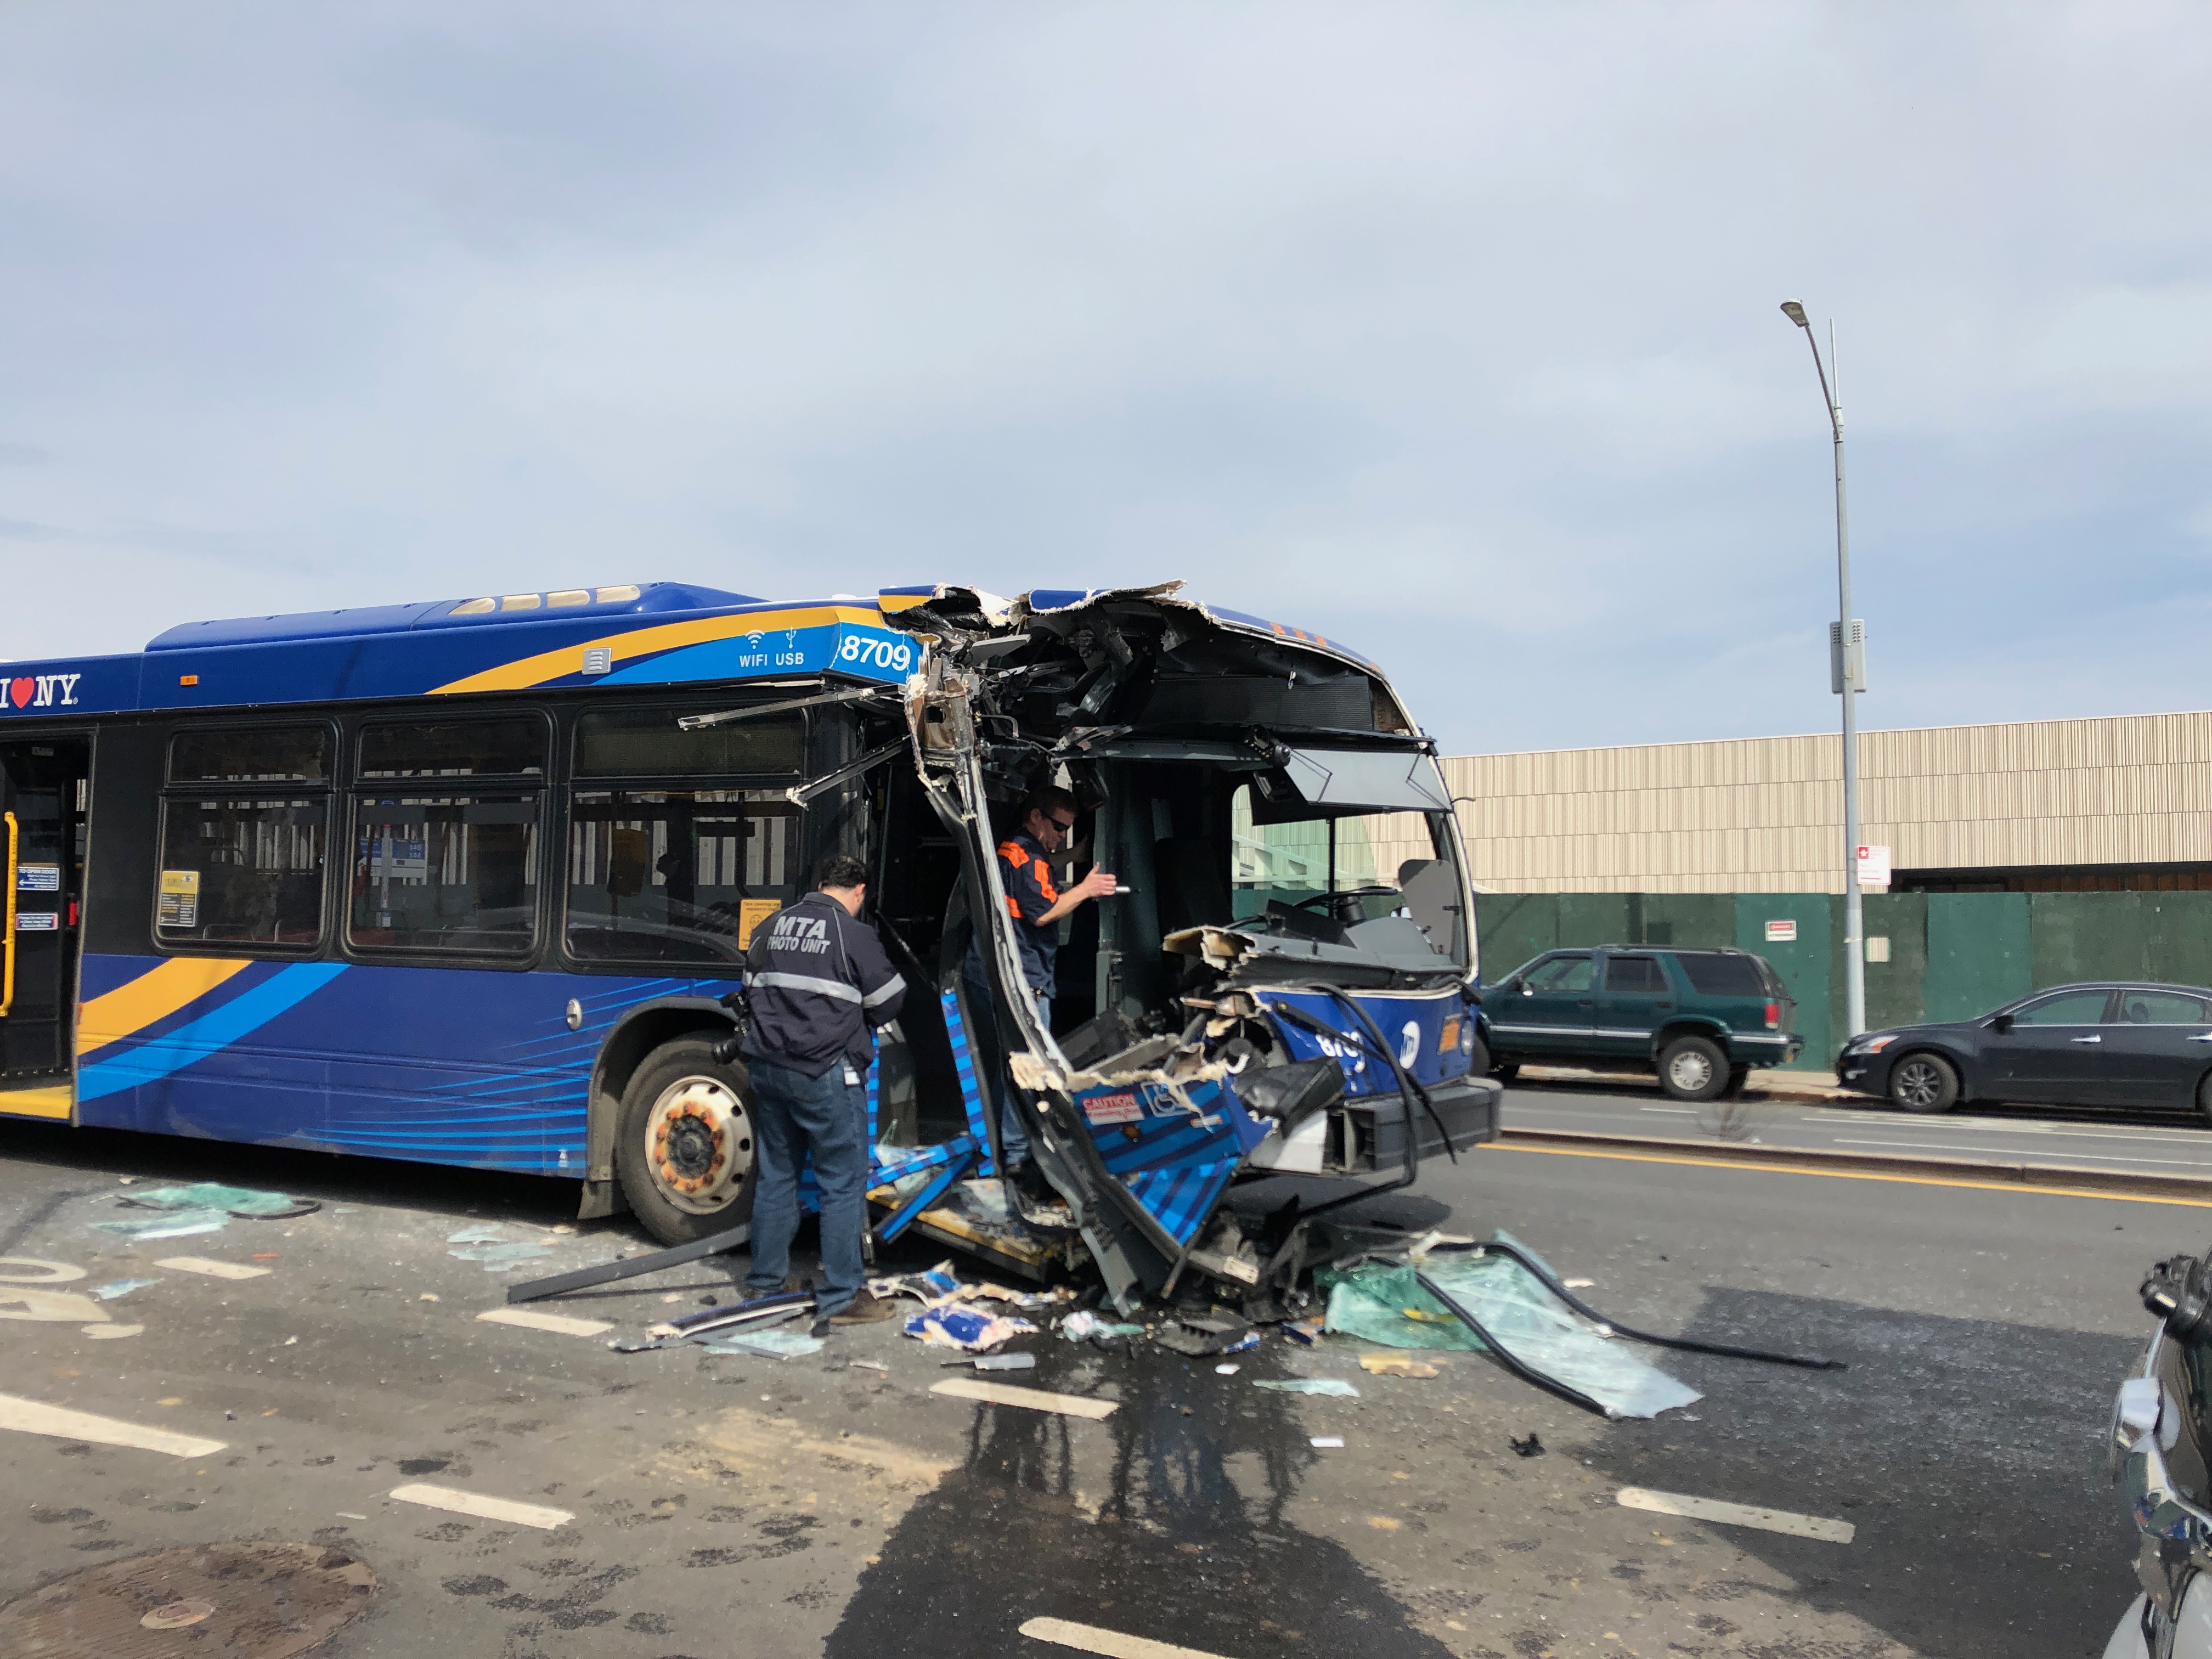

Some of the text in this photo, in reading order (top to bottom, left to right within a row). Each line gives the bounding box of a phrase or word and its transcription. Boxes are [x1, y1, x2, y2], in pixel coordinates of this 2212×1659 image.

[739, 652, 804, 668] WIFI USB
[841, 635, 910, 671] 8709
[0, 678, 11, 708] I
[773, 916, 827, 939] MTA
[801, 938, 831, 955] UNIT
[1082, 1094, 1136, 1110] CAUTION
